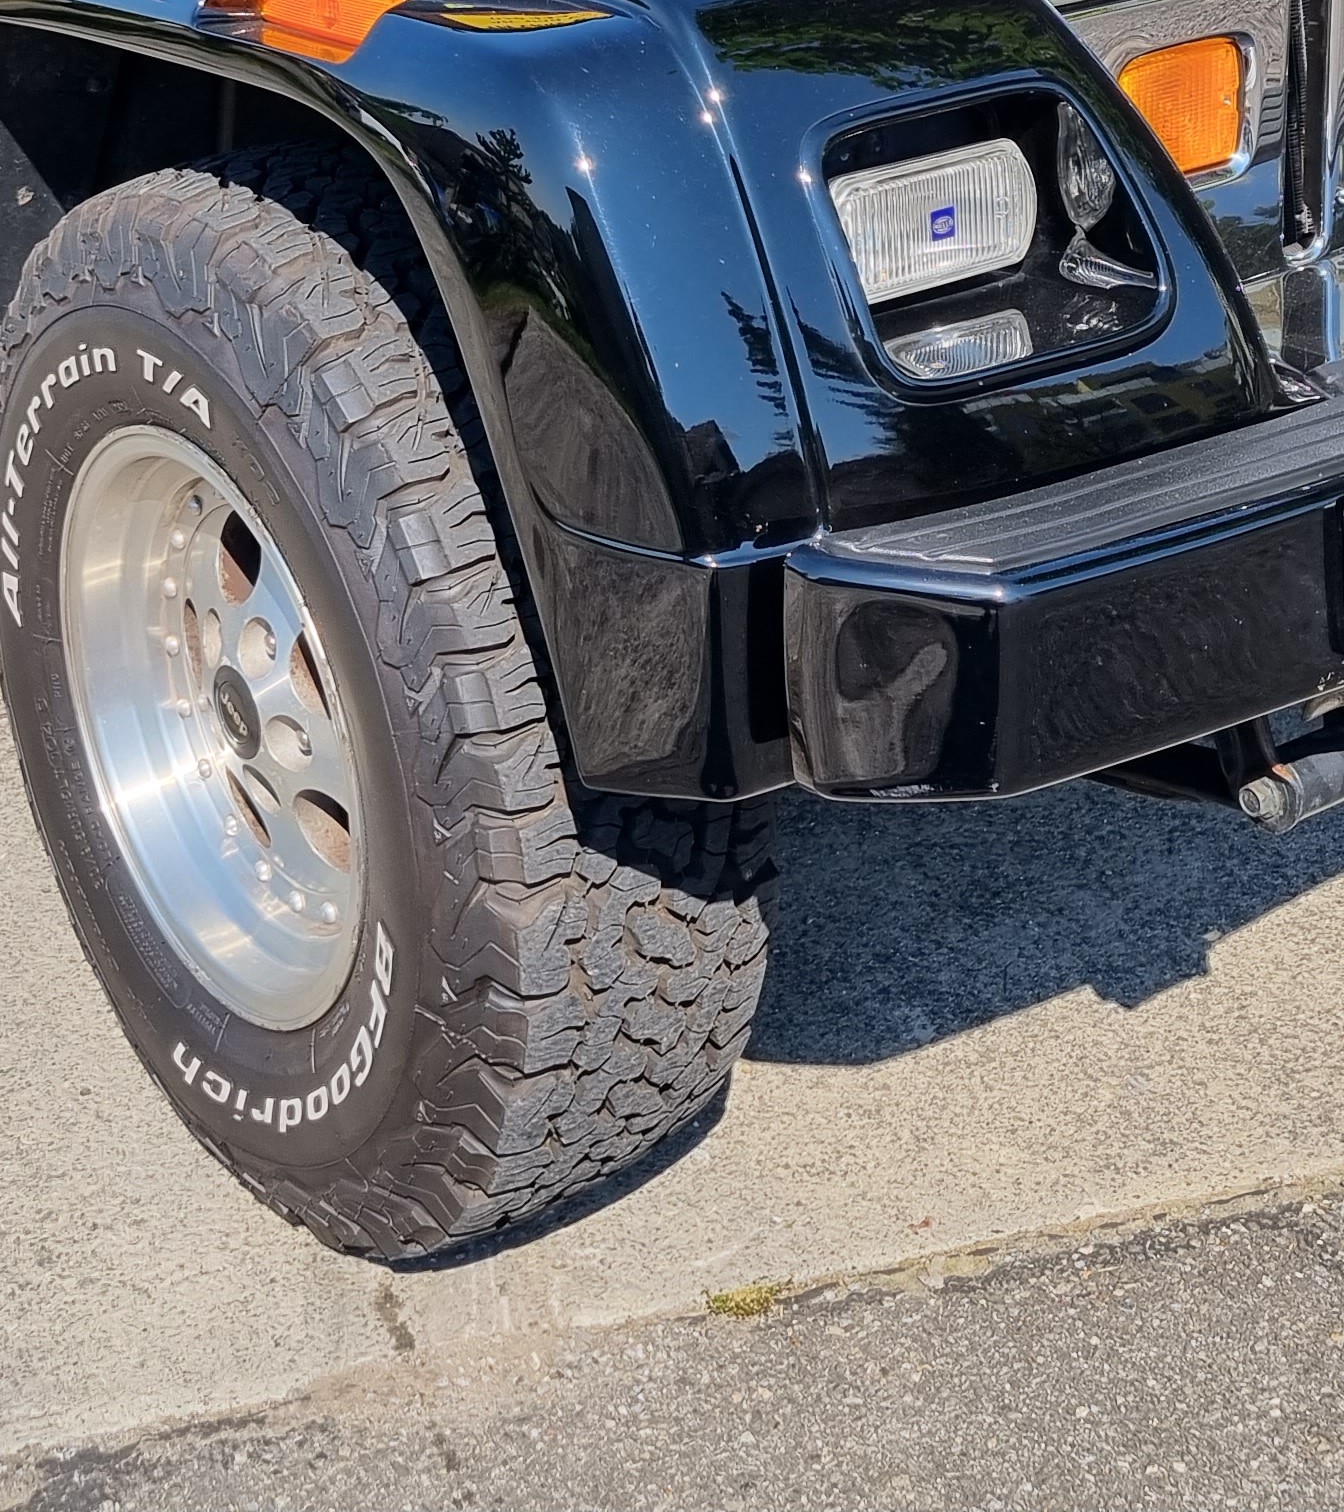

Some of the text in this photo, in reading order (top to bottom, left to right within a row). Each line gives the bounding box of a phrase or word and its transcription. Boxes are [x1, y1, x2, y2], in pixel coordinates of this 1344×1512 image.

[1, 343, 116, 627] All-Terrain
[136, 349, 211, 429] T/A
[220, 691, 248, 737] Jeep
